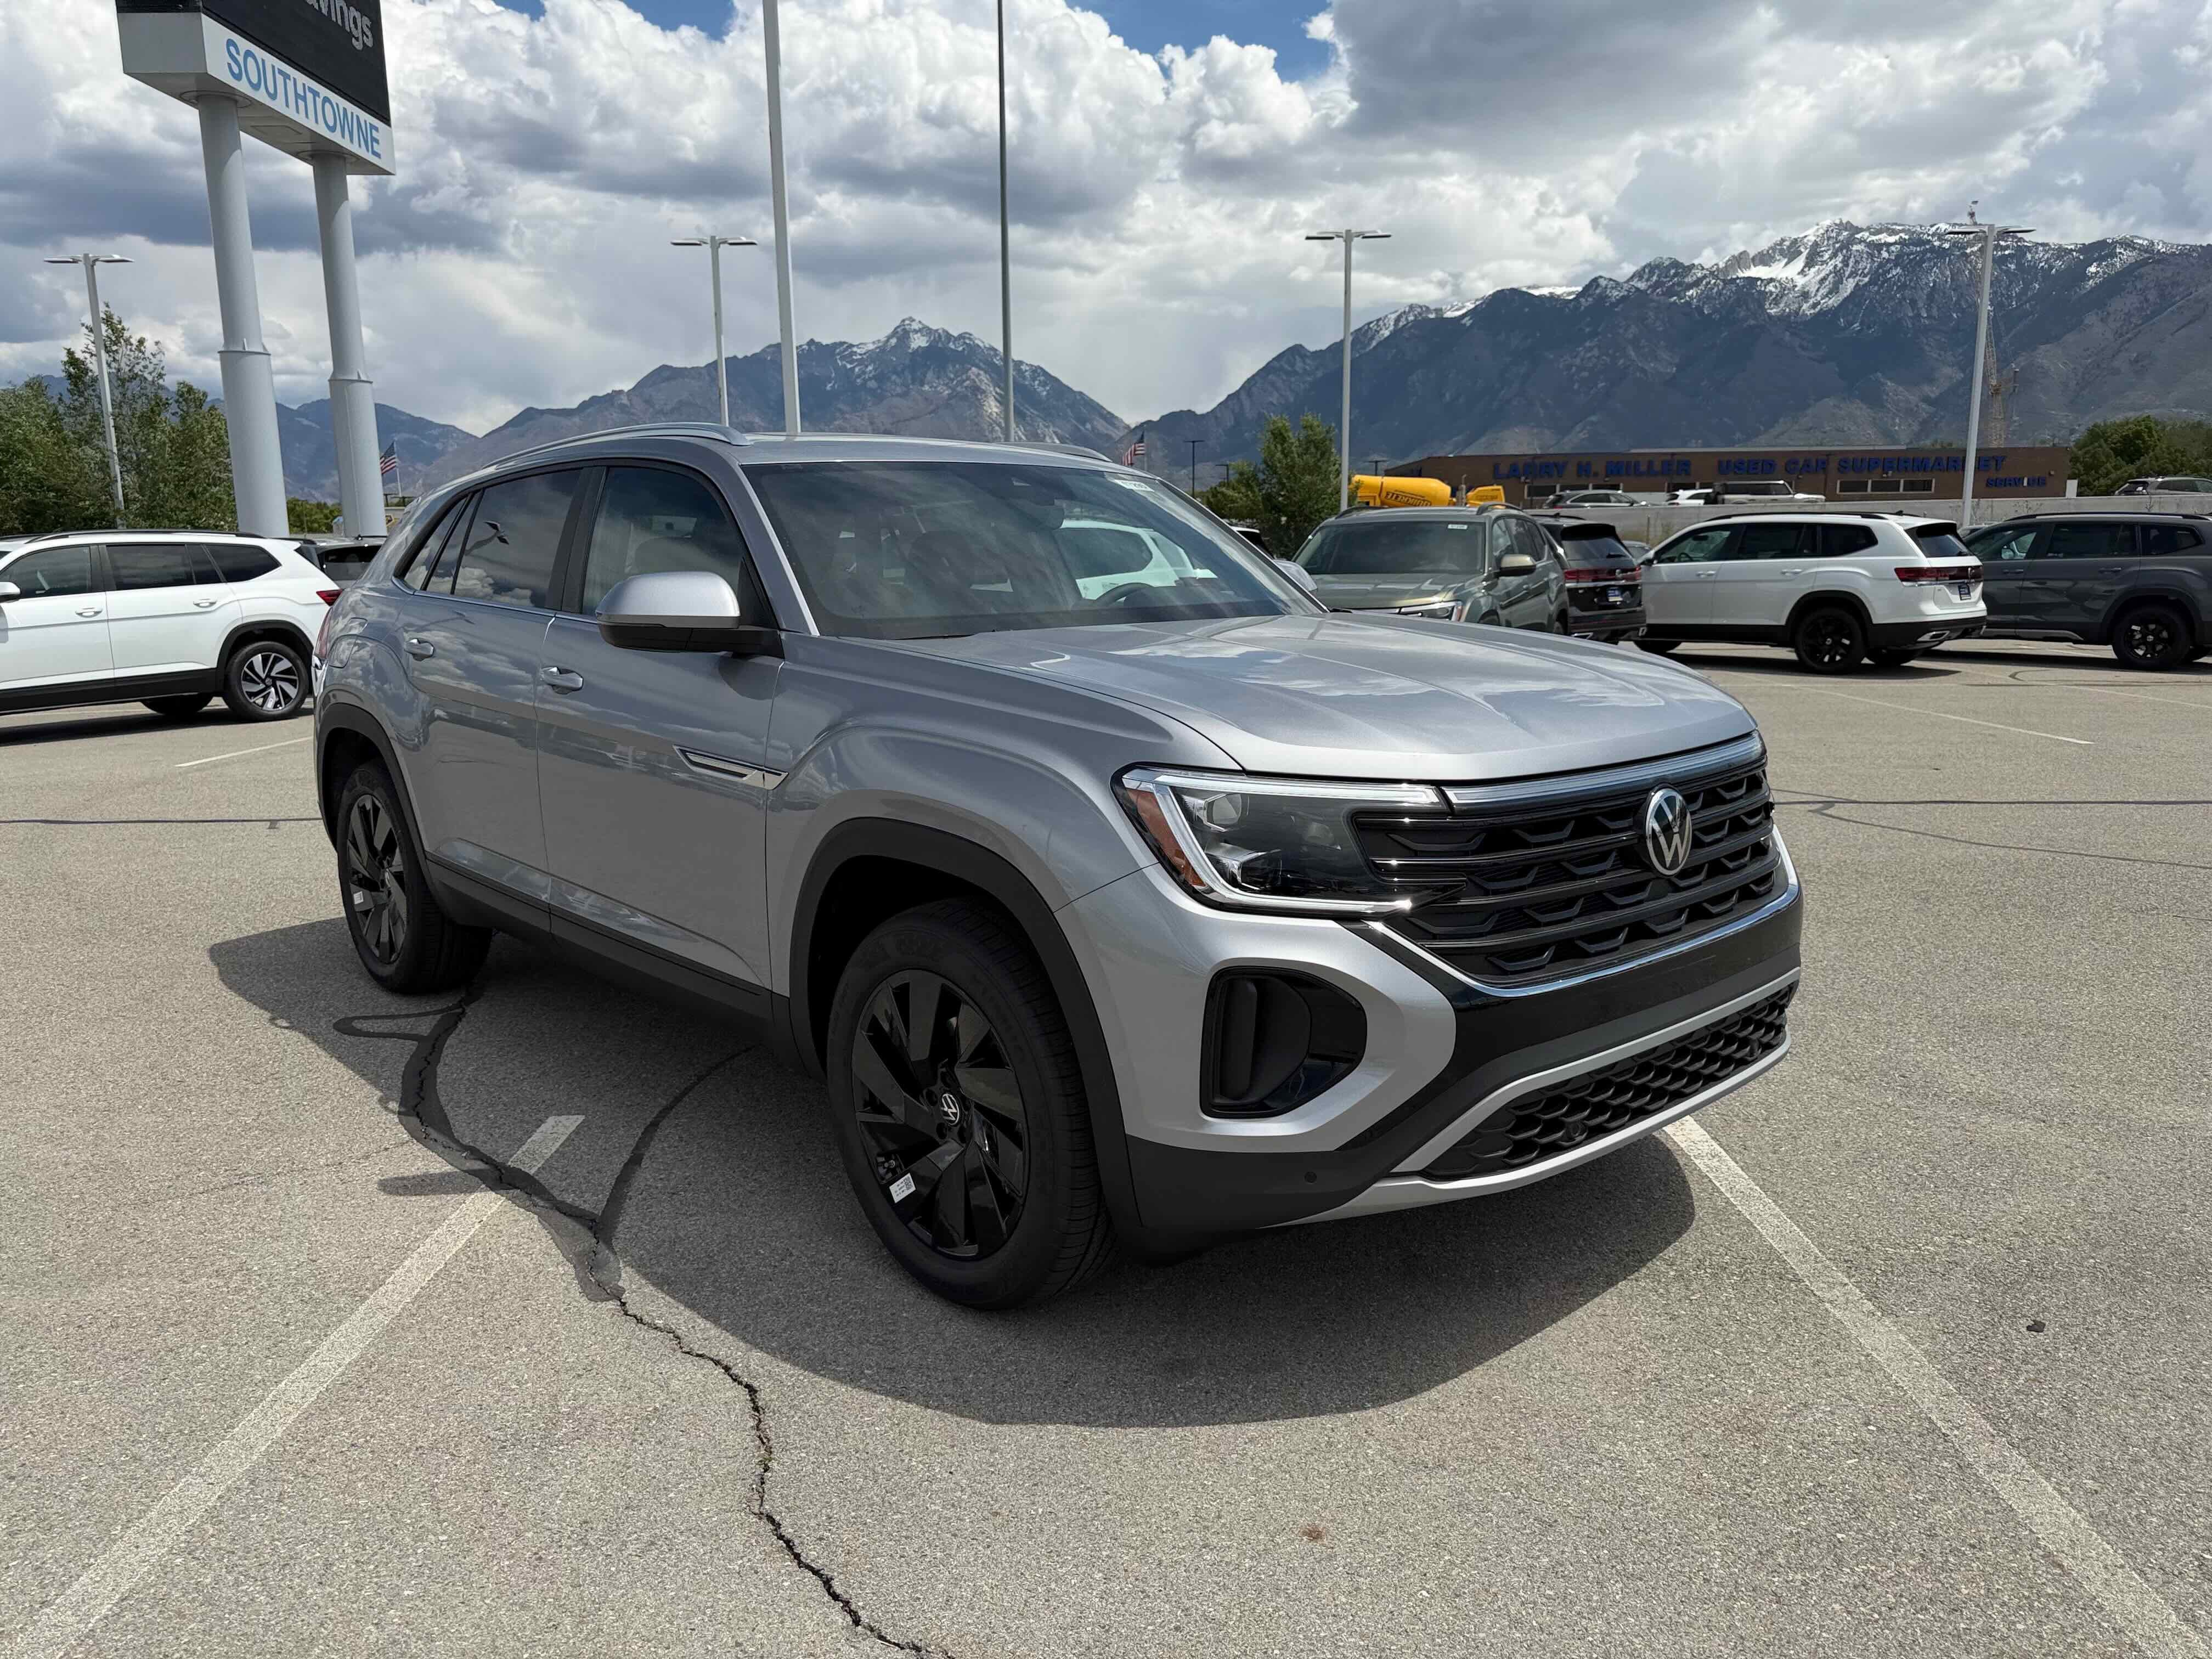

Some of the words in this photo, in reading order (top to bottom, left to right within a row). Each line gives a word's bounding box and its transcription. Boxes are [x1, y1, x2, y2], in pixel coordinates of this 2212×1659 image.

[225, 38, 382, 159] SOUTHTOWNE
[1494, 460, 1568, 479] LARRY
[1605, 459, 1691, 476] MILLER
[1717, 459, 1777, 476] USED
[1837, 456, 2006, 474] SUPERMARET
[1986, 476, 2046, 488] SERVCE
